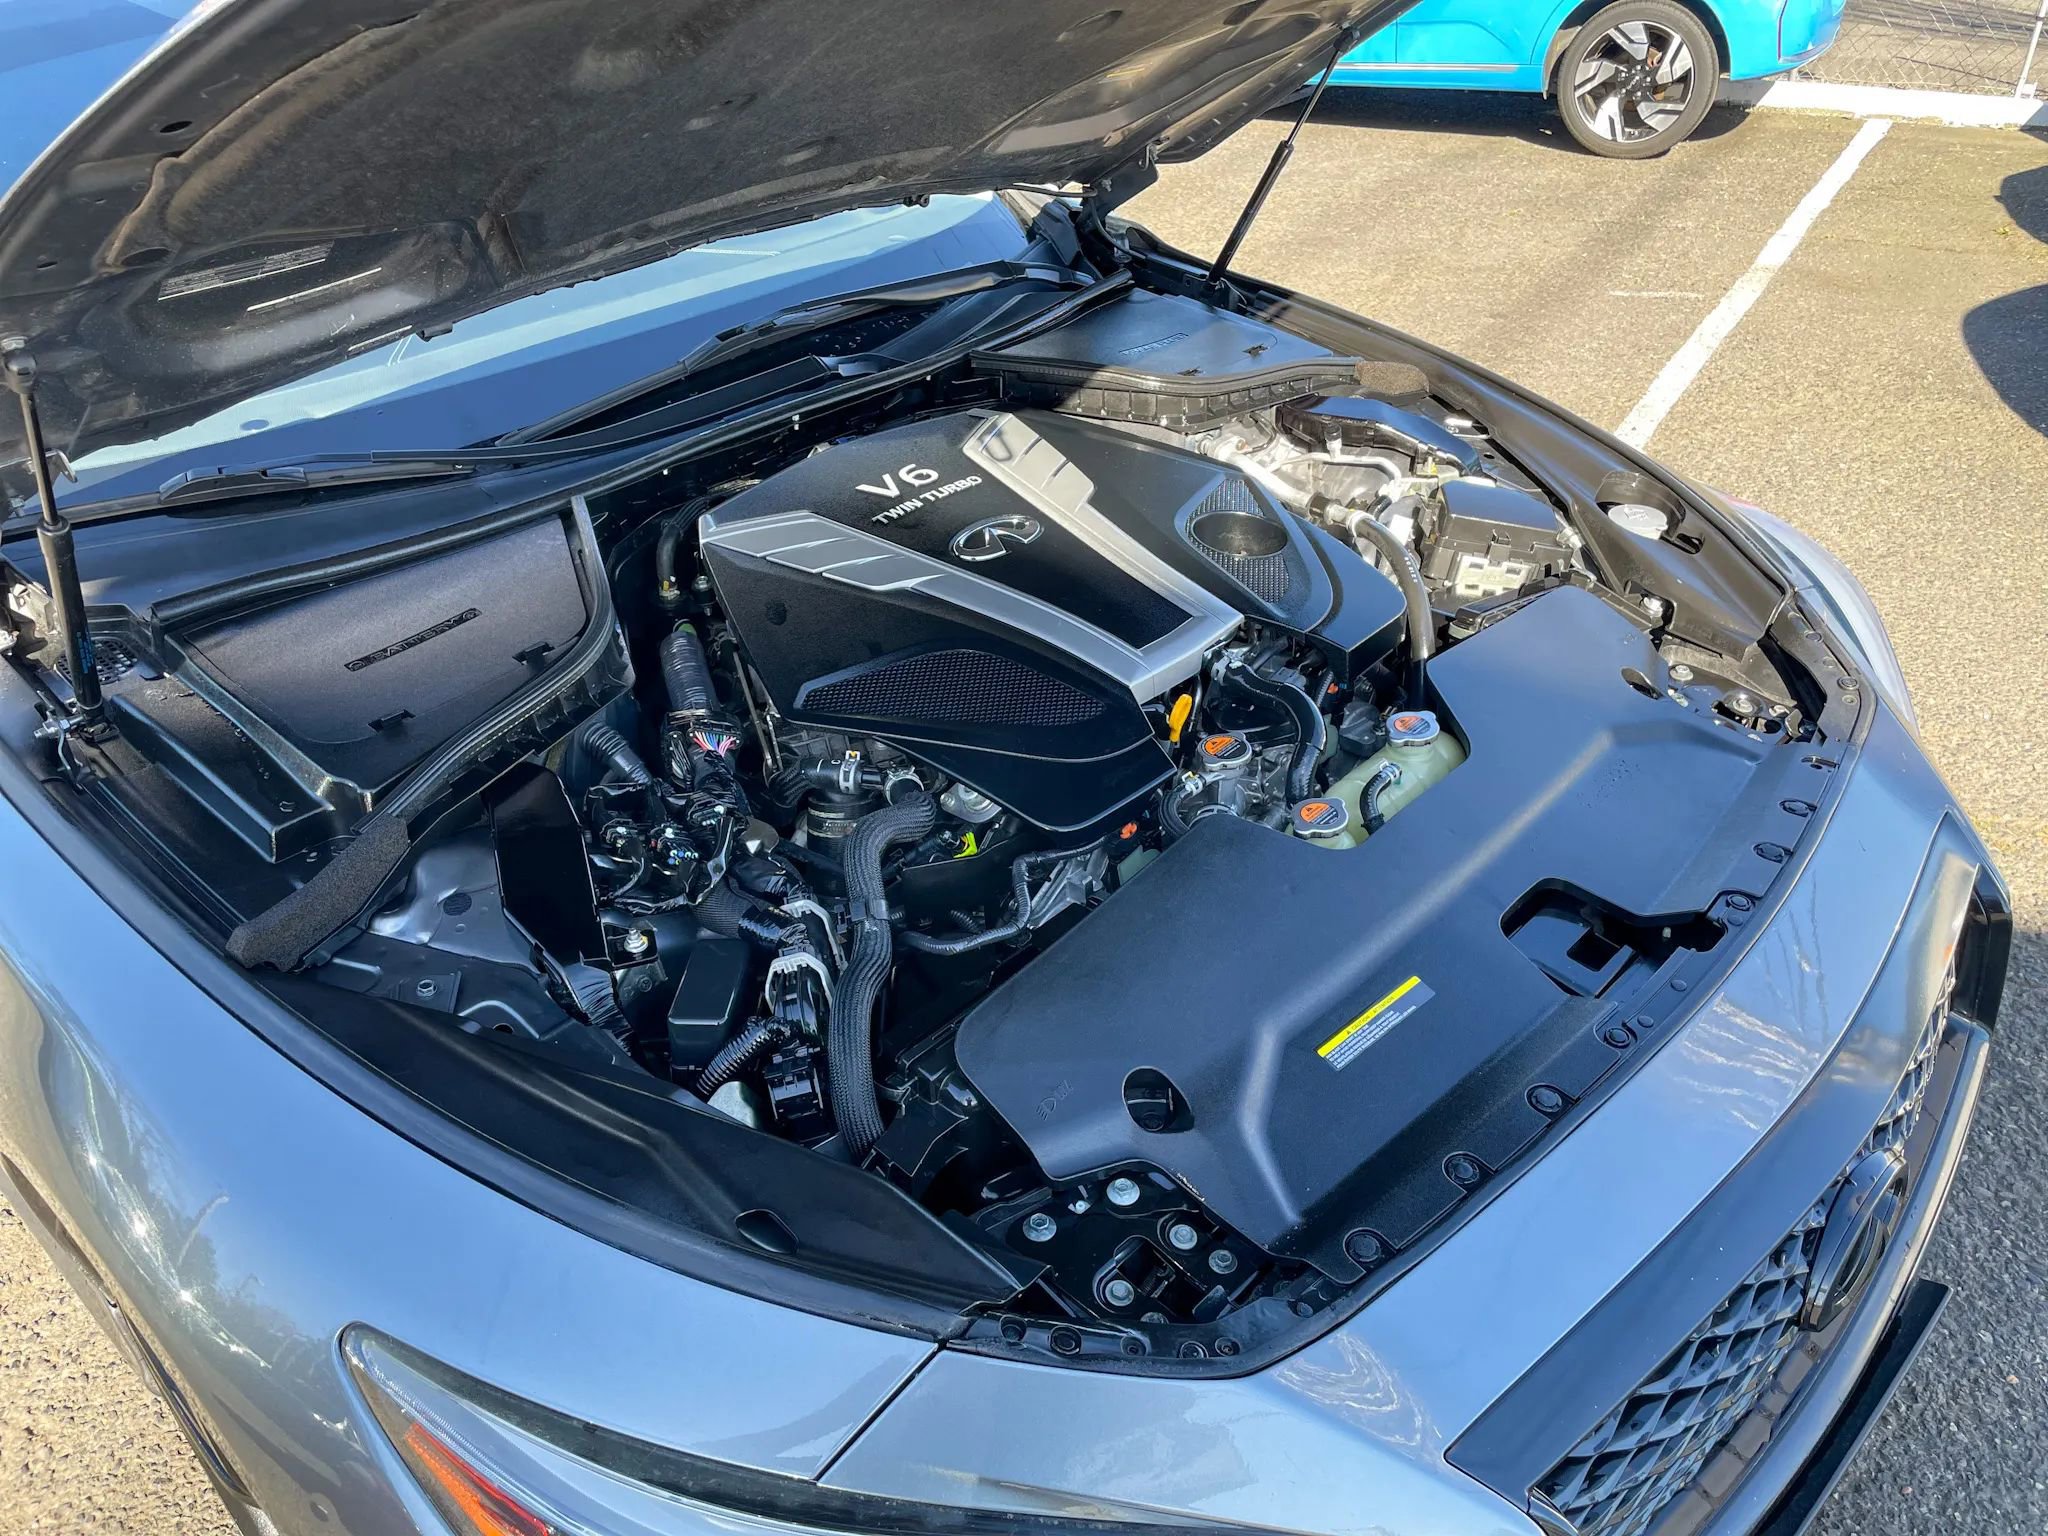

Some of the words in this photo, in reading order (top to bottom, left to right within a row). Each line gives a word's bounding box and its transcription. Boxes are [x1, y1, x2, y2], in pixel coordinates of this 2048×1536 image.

[855, 463, 939, 498] V6
[871, 499, 924, 525] TWIN
[919, 475, 983, 502] TURBO
[369, 618, 458, 661] BATTERY
